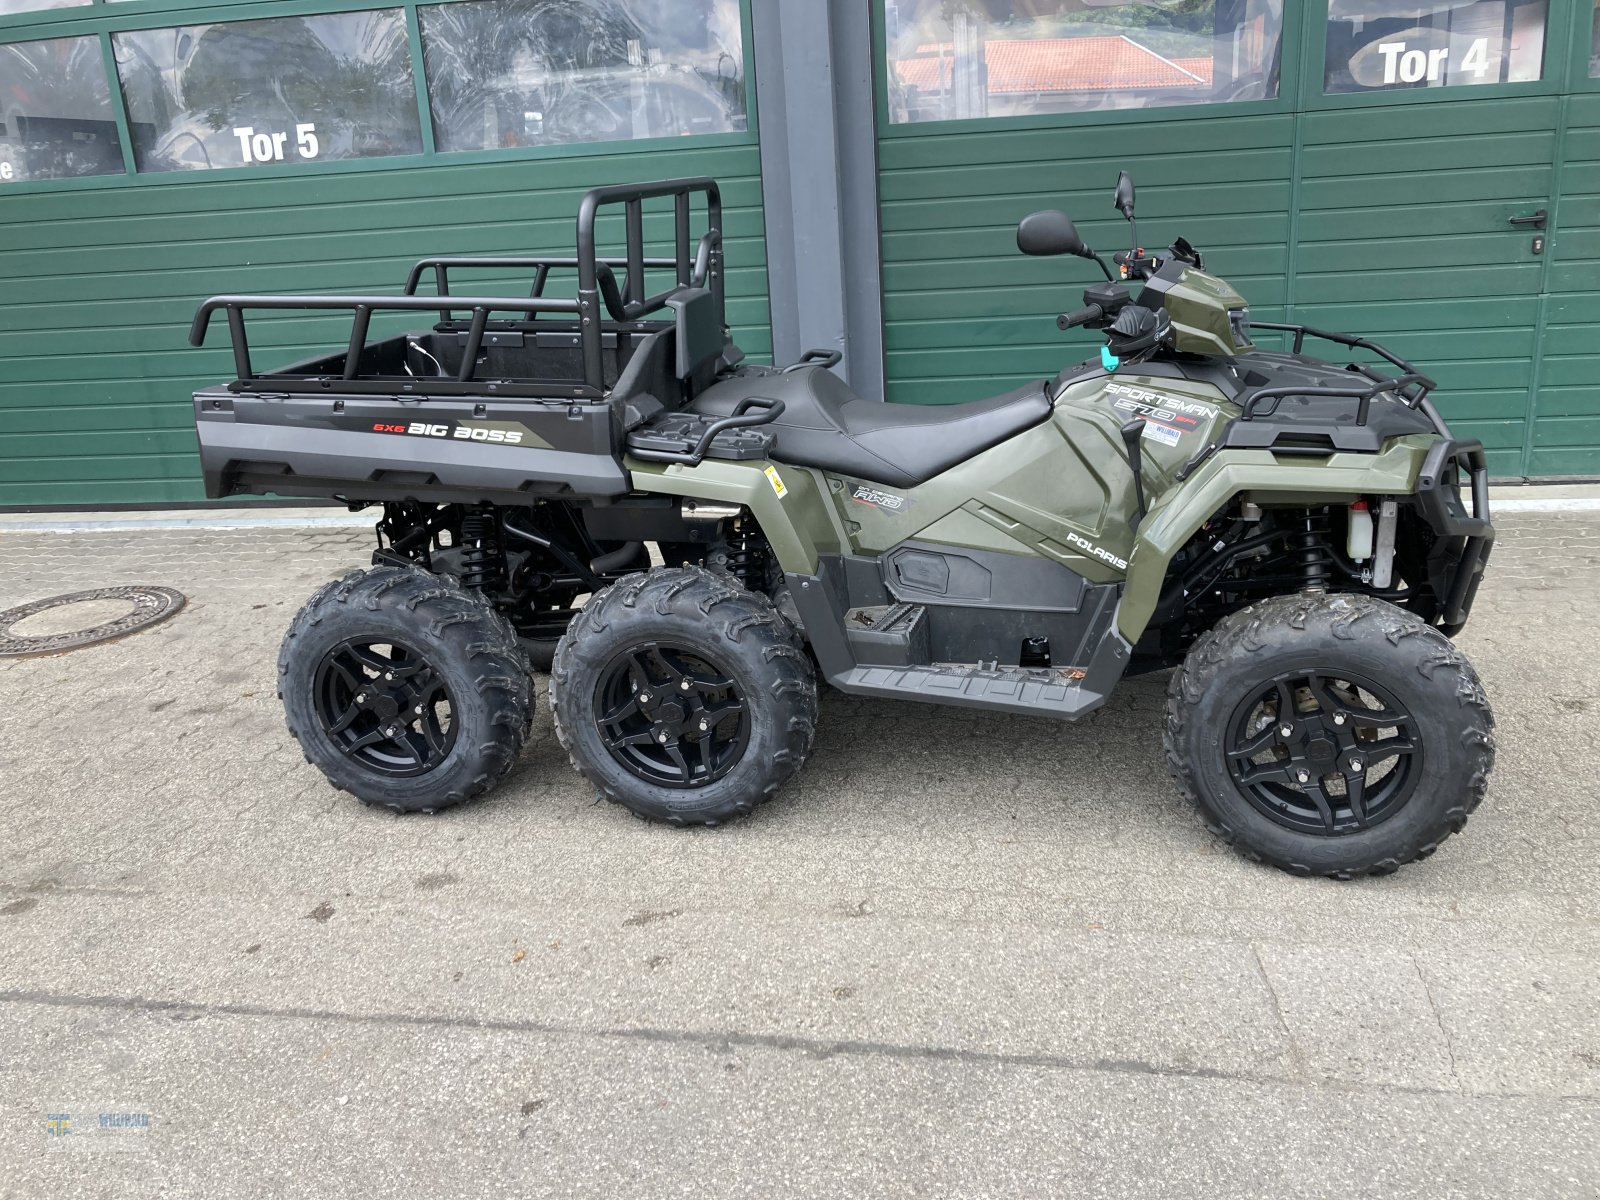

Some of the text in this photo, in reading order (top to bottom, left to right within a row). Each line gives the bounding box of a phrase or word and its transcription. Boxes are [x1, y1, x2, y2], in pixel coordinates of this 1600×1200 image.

[1378, 37, 1489, 84] Tor 4
[233, 122, 319, 163] Tor 5
[0, 161, 14, 180] e
[1103, 383, 1219, 419] SPORTSMAN
[1114, 397, 1177, 422] 570
[407, 422, 449, 437] BIG
[453, 426, 523, 444] BOSS
[853, 489, 902, 509] AWD
[1066, 532, 1128, 570] POLARIS
